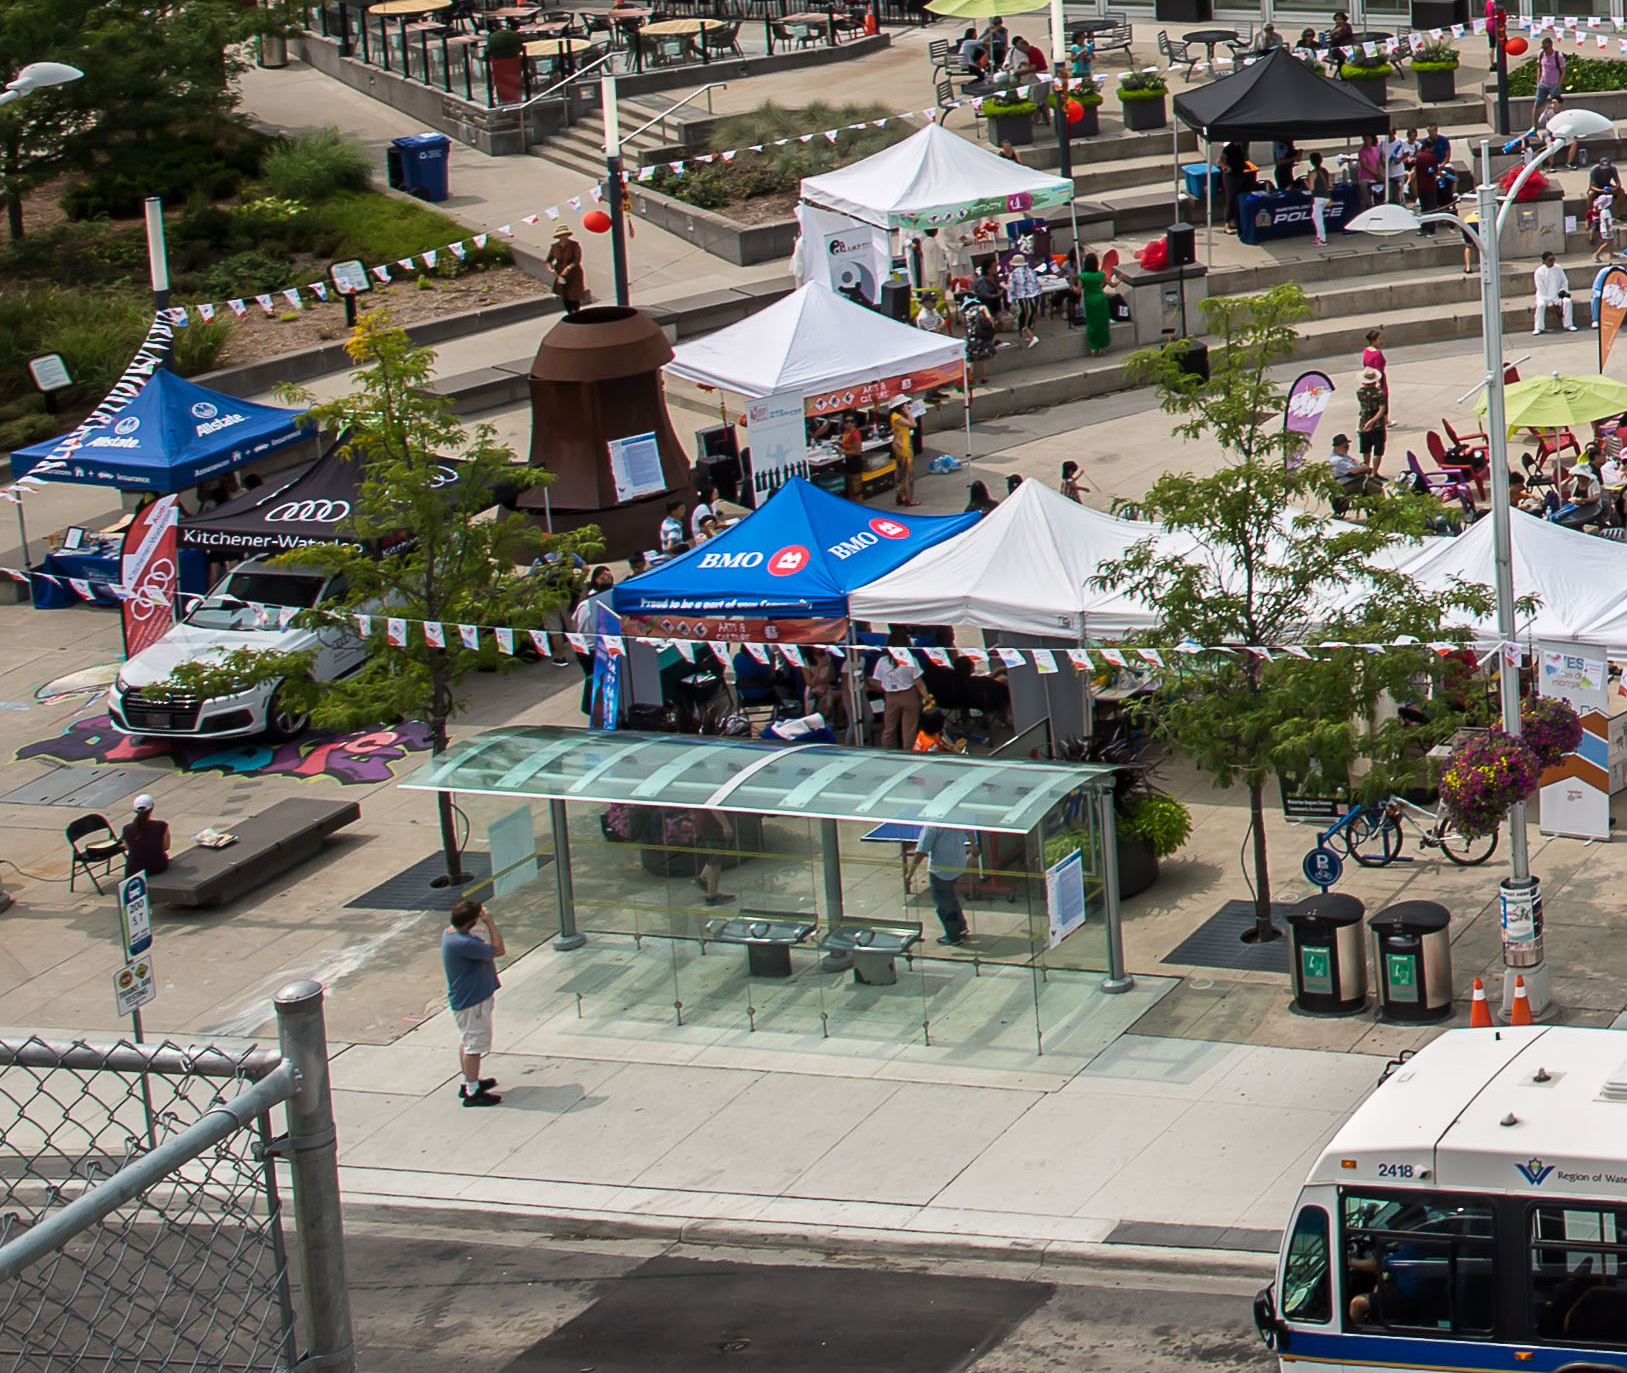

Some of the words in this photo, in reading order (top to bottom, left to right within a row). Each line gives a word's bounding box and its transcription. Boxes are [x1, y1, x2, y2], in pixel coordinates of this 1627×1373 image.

[1273, 207, 1344, 225] POLCE
[195, 412, 247, 439] Allstate
[88, 435, 141, 450] Allstate
[828, 531, 879, 560] BMO
[697, 551, 763, 569] BMO
[1563, 656, 1585, 671] ES
[1378, 1163, 1414, 1178] 2418
[1557, 1171, 1591, 1183] Region
[1592, 1172, 1604, 1182] of
